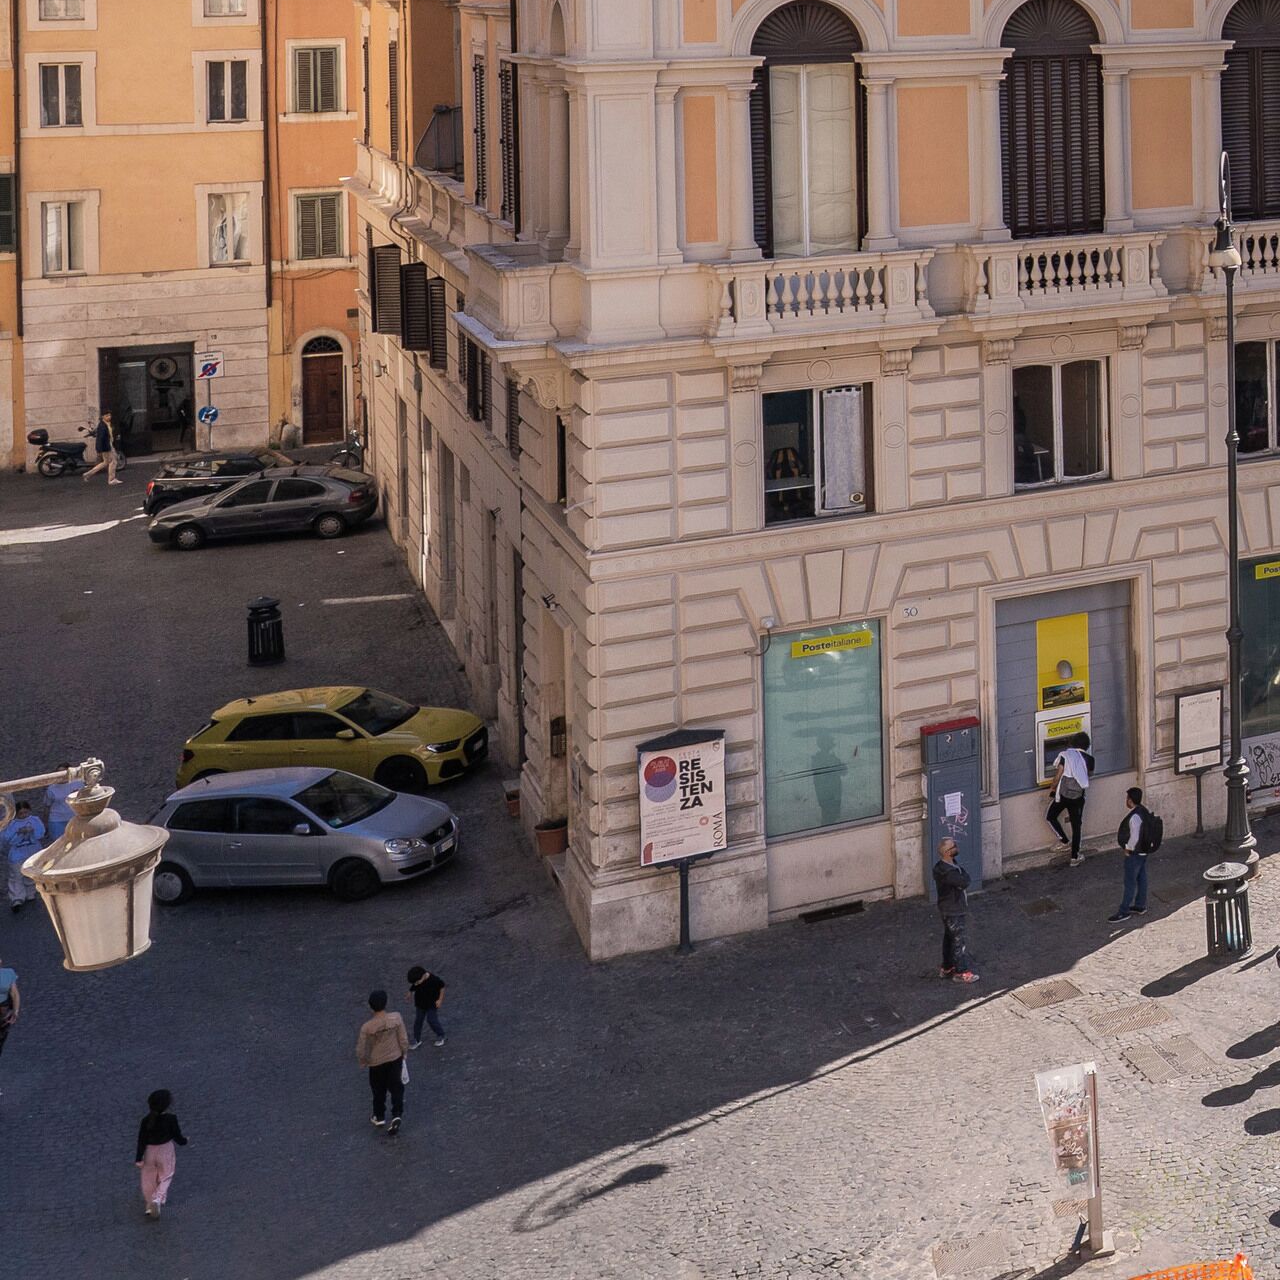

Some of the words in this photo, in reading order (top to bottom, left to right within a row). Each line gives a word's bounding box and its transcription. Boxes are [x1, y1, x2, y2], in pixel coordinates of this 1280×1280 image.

[903, 607, 919, 618] 30
[679, 758, 702, 773] RE
[679, 770, 706, 785] SIS
[679, 781, 713, 797] TEN
[680, 796, 703, 811] ZA
[713, 811, 724, 848] ROMA
